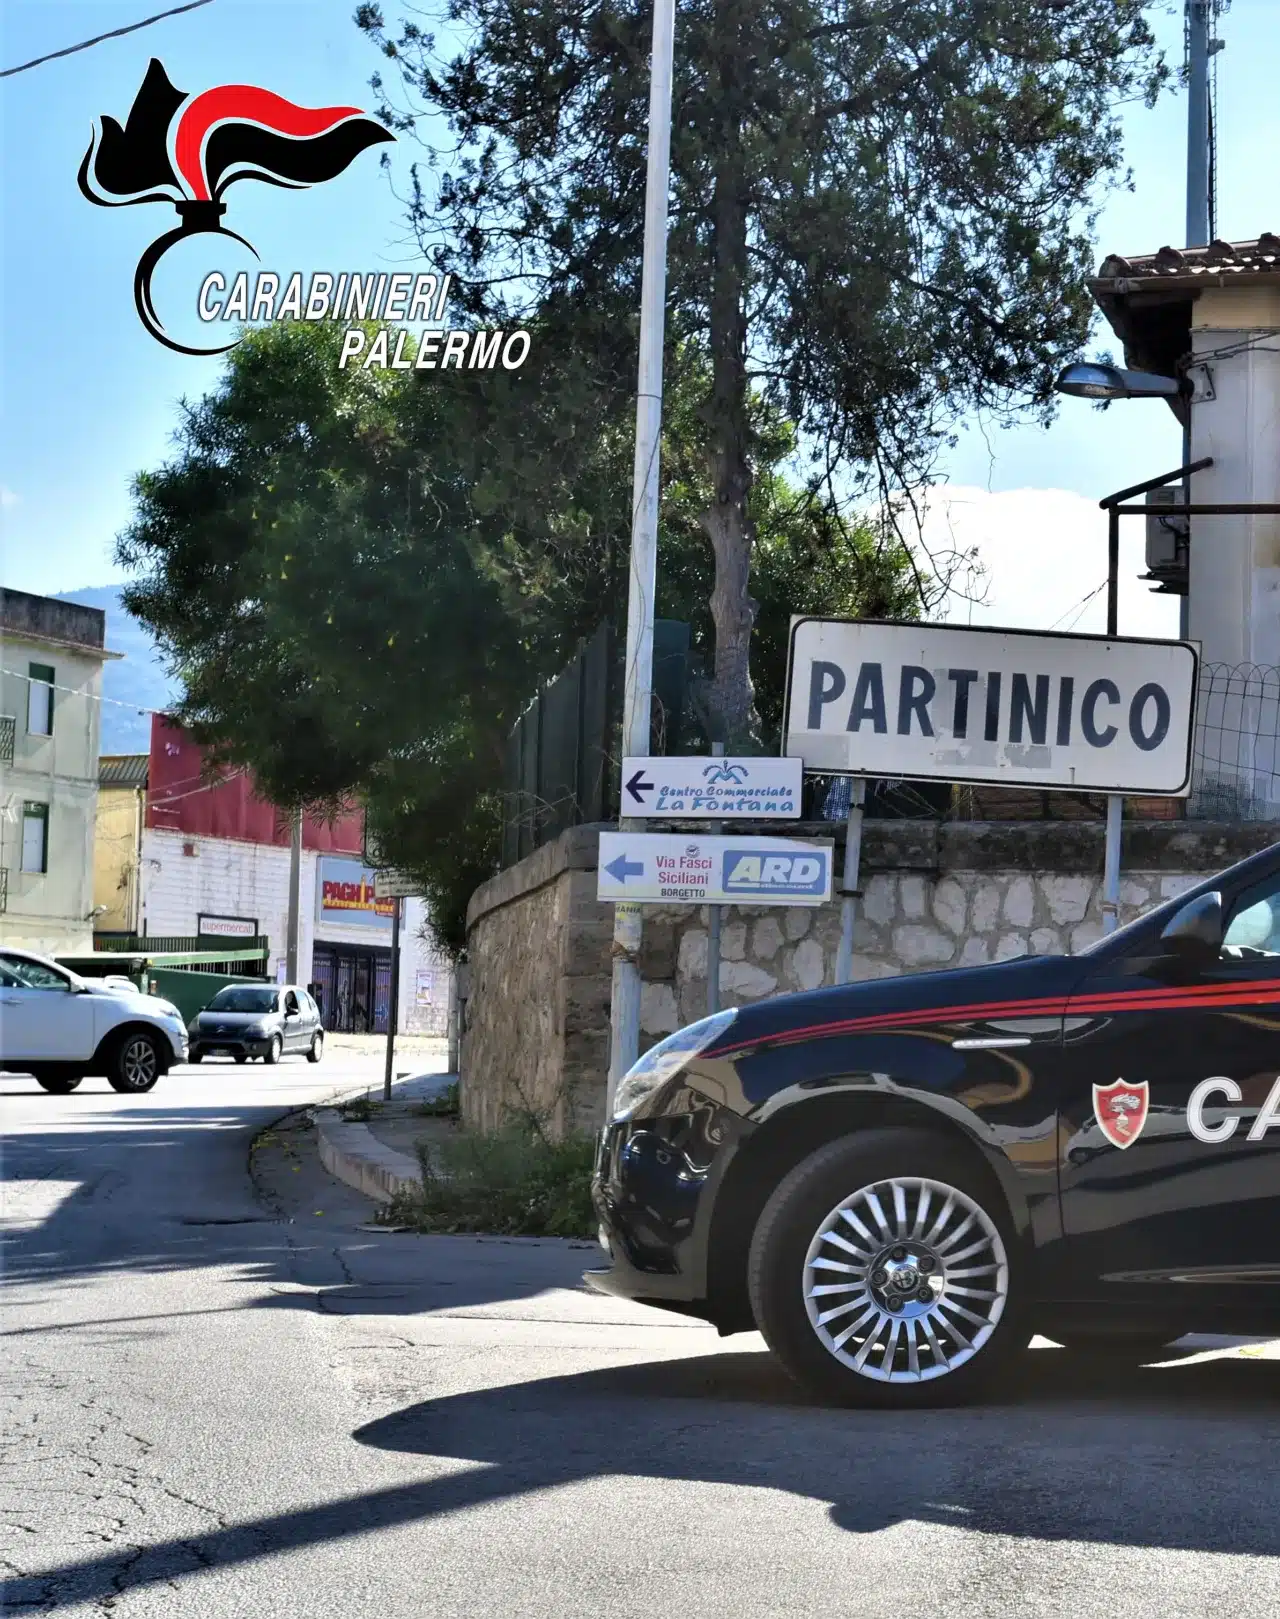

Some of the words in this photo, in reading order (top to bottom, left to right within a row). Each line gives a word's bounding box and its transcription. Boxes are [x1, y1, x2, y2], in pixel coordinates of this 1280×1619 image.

[807, 660, 1171, 752] PARTINICO
[691, 797, 793, 812] Fontana
[656, 856, 675, 868] Via
[680, 856, 712, 869] Fasci
[727, 856, 821, 883] ARD
[658, 871, 708, 884] Siciliani
[661, 888, 705, 897] BORGETTO
